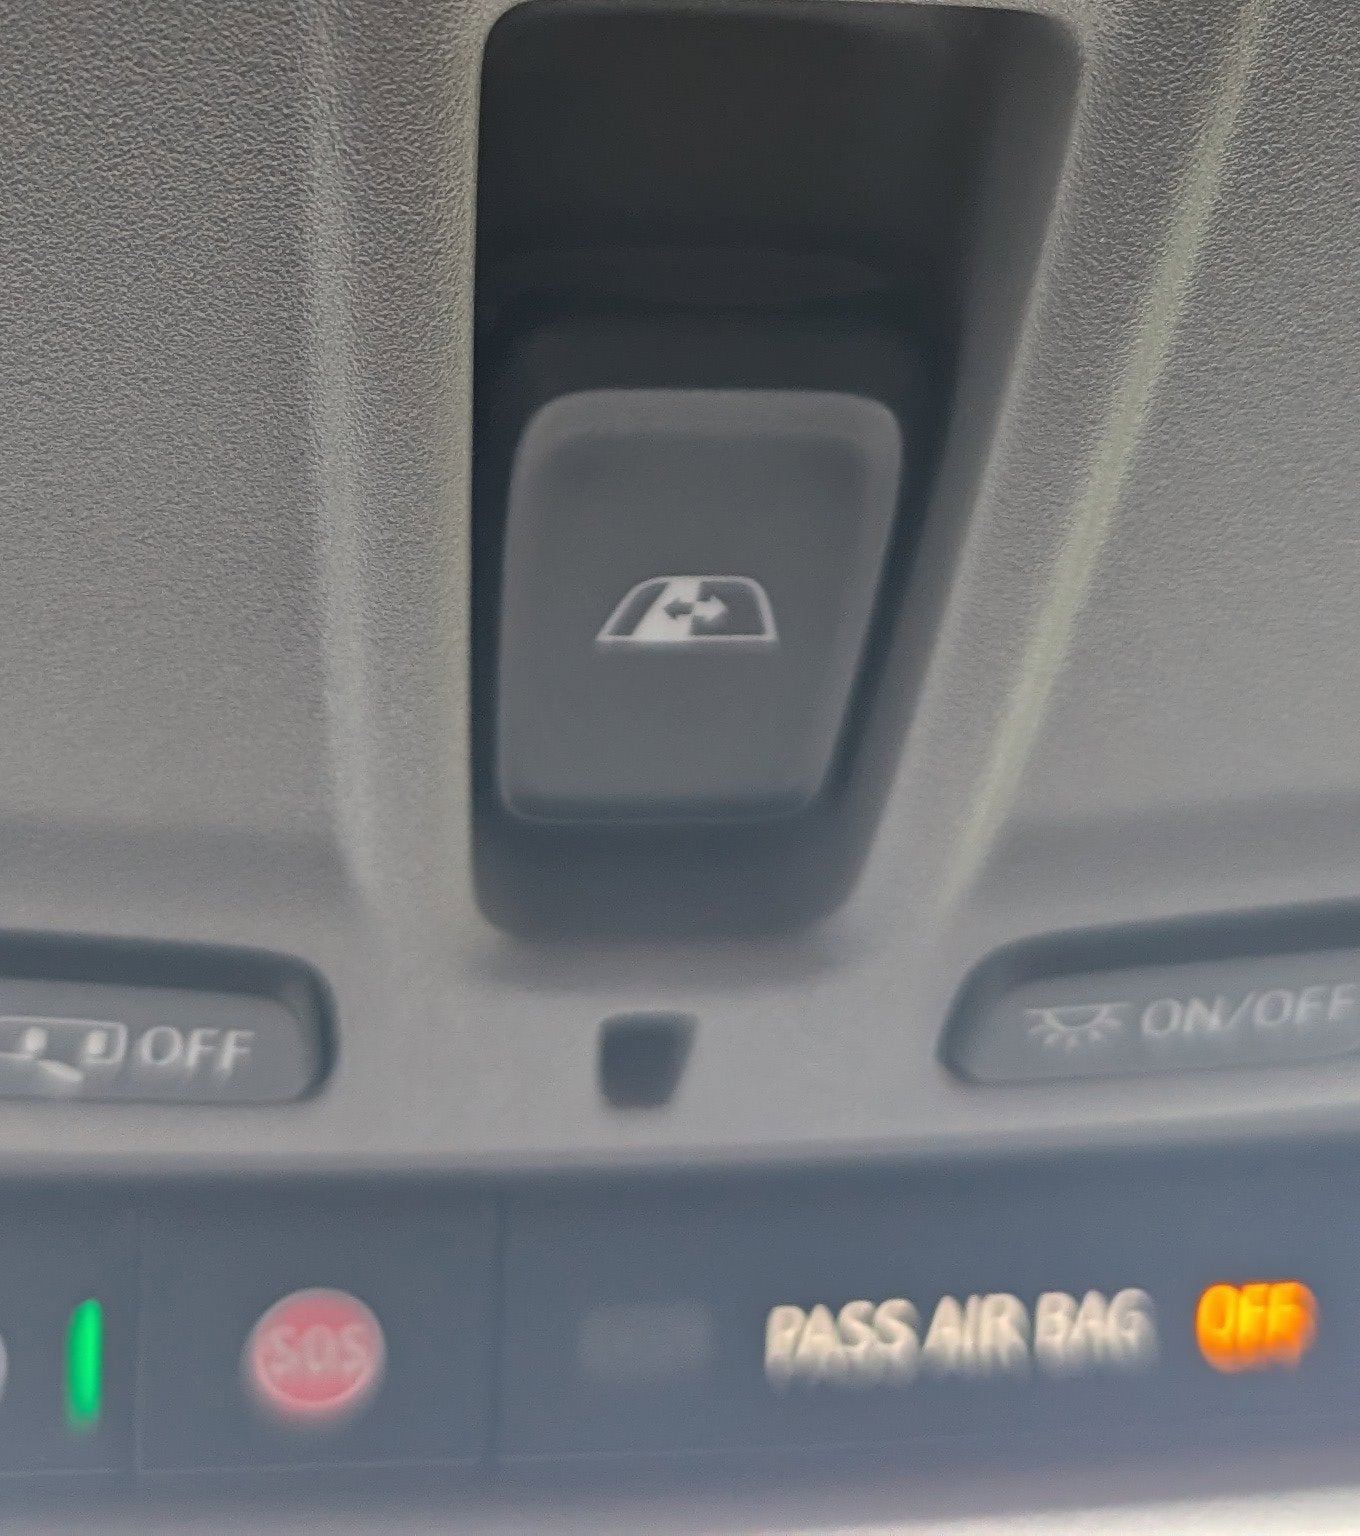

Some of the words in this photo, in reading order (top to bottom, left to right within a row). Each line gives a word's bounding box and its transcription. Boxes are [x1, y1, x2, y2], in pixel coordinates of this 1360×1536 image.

[1141, 982, 1357, 1039] ON/OFF
[140, 1025, 255, 1071] OFF
[262, 1320, 370, 1380] SOS
[764, 1298, 920, 1380] PASS
[920, 1290, 1030, 1374] AIR
[1033, 1287, 1154, 1362] BAG
[1196, 1280, 1317, 1370] OFF
